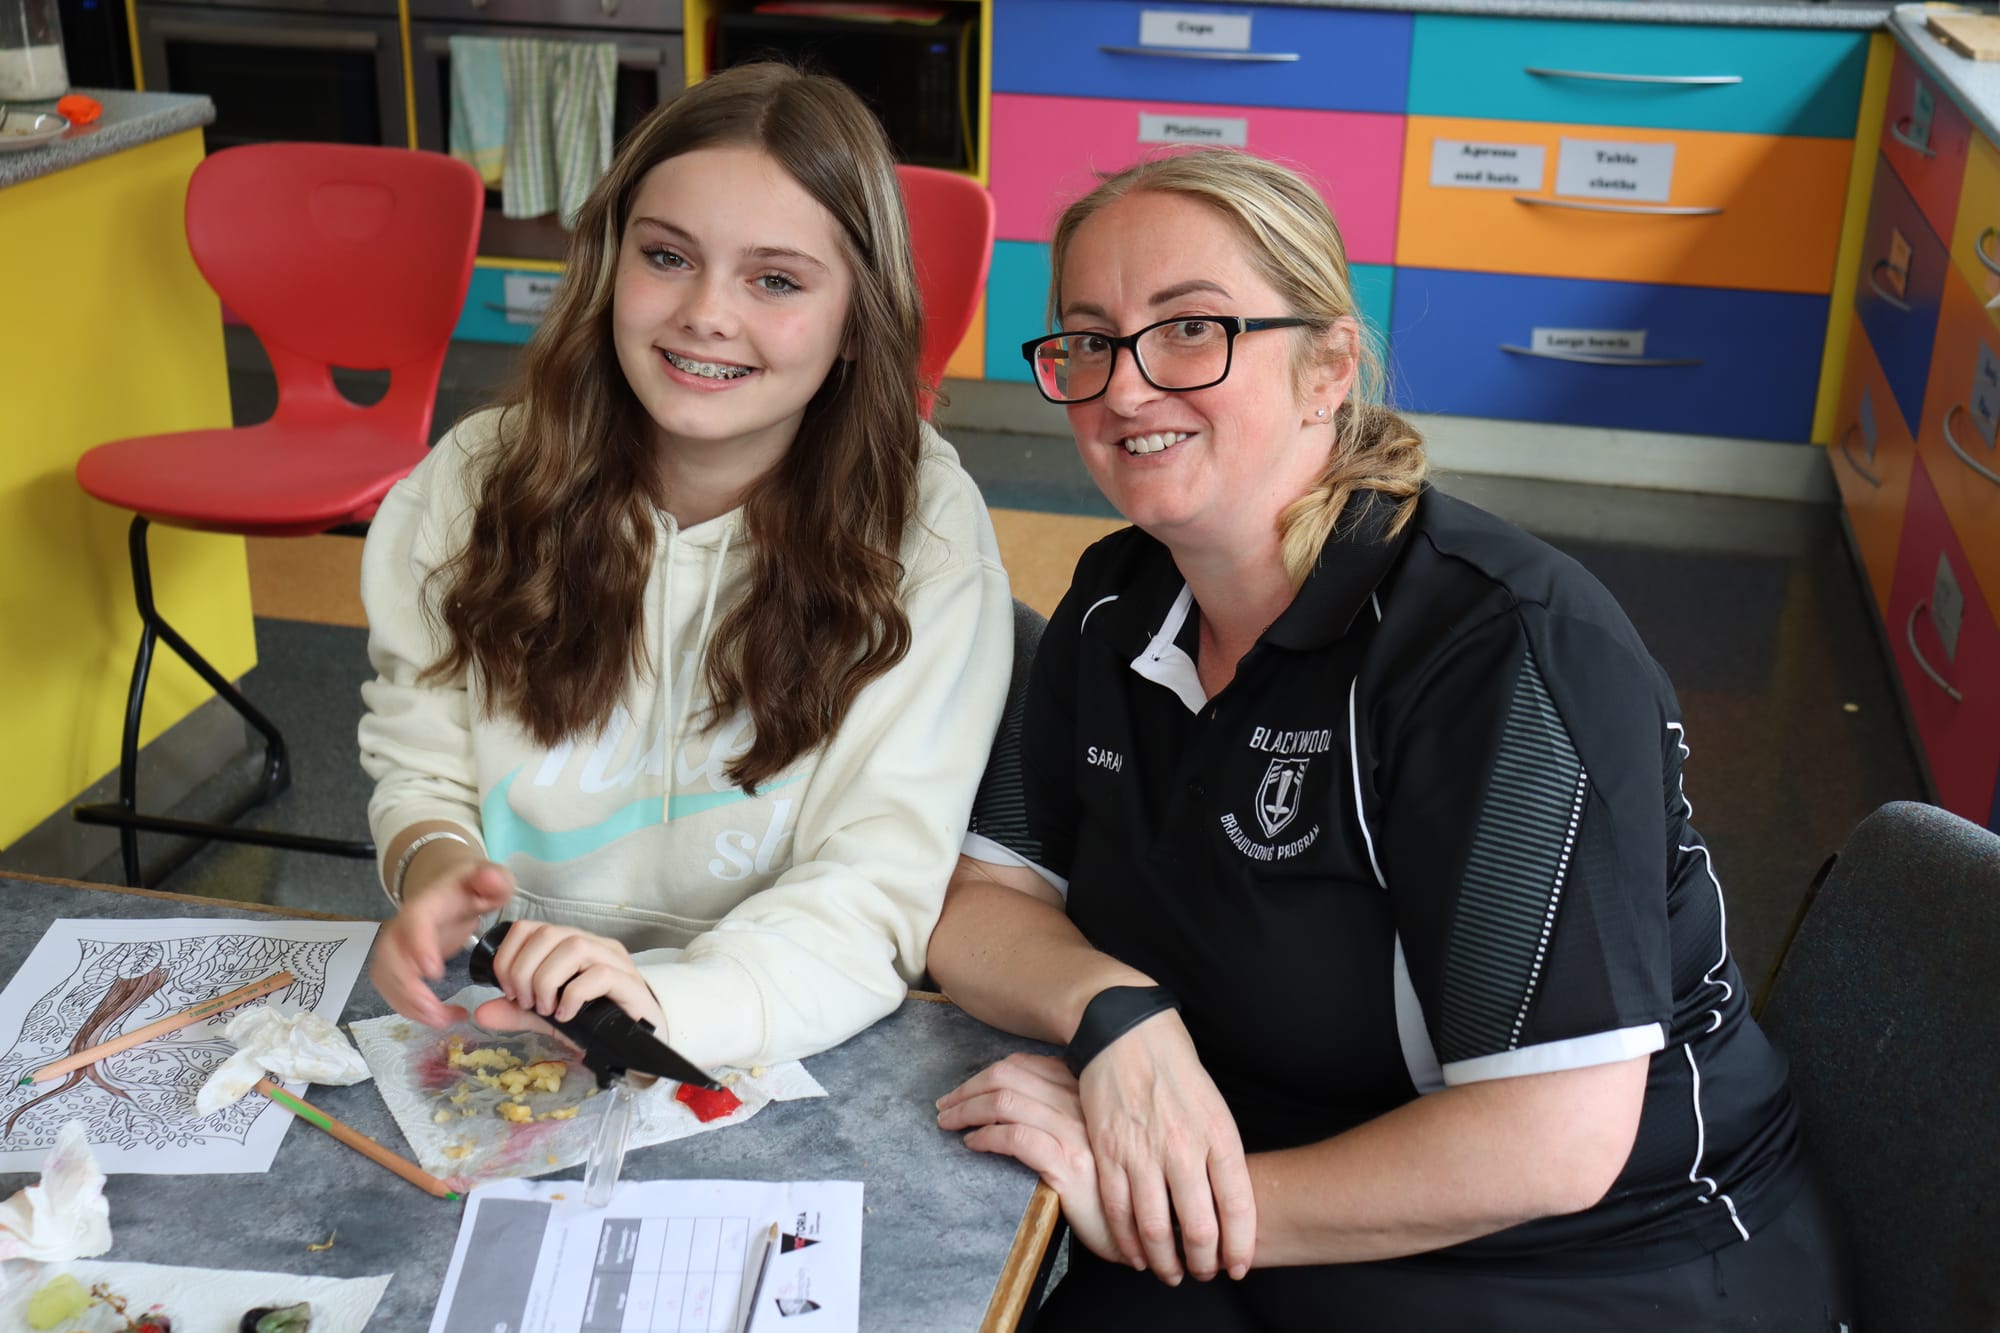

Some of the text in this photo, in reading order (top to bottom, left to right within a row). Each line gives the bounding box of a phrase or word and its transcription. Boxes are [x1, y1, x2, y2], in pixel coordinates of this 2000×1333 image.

[1176, 21, 1214, 36] Cups
[1461, 144, 1517, 160] Aprons
[1596, 150, 1637, 164] Table
[1454, 170, 1482, 182] and
[1546, 334, 1584, 349] Large
